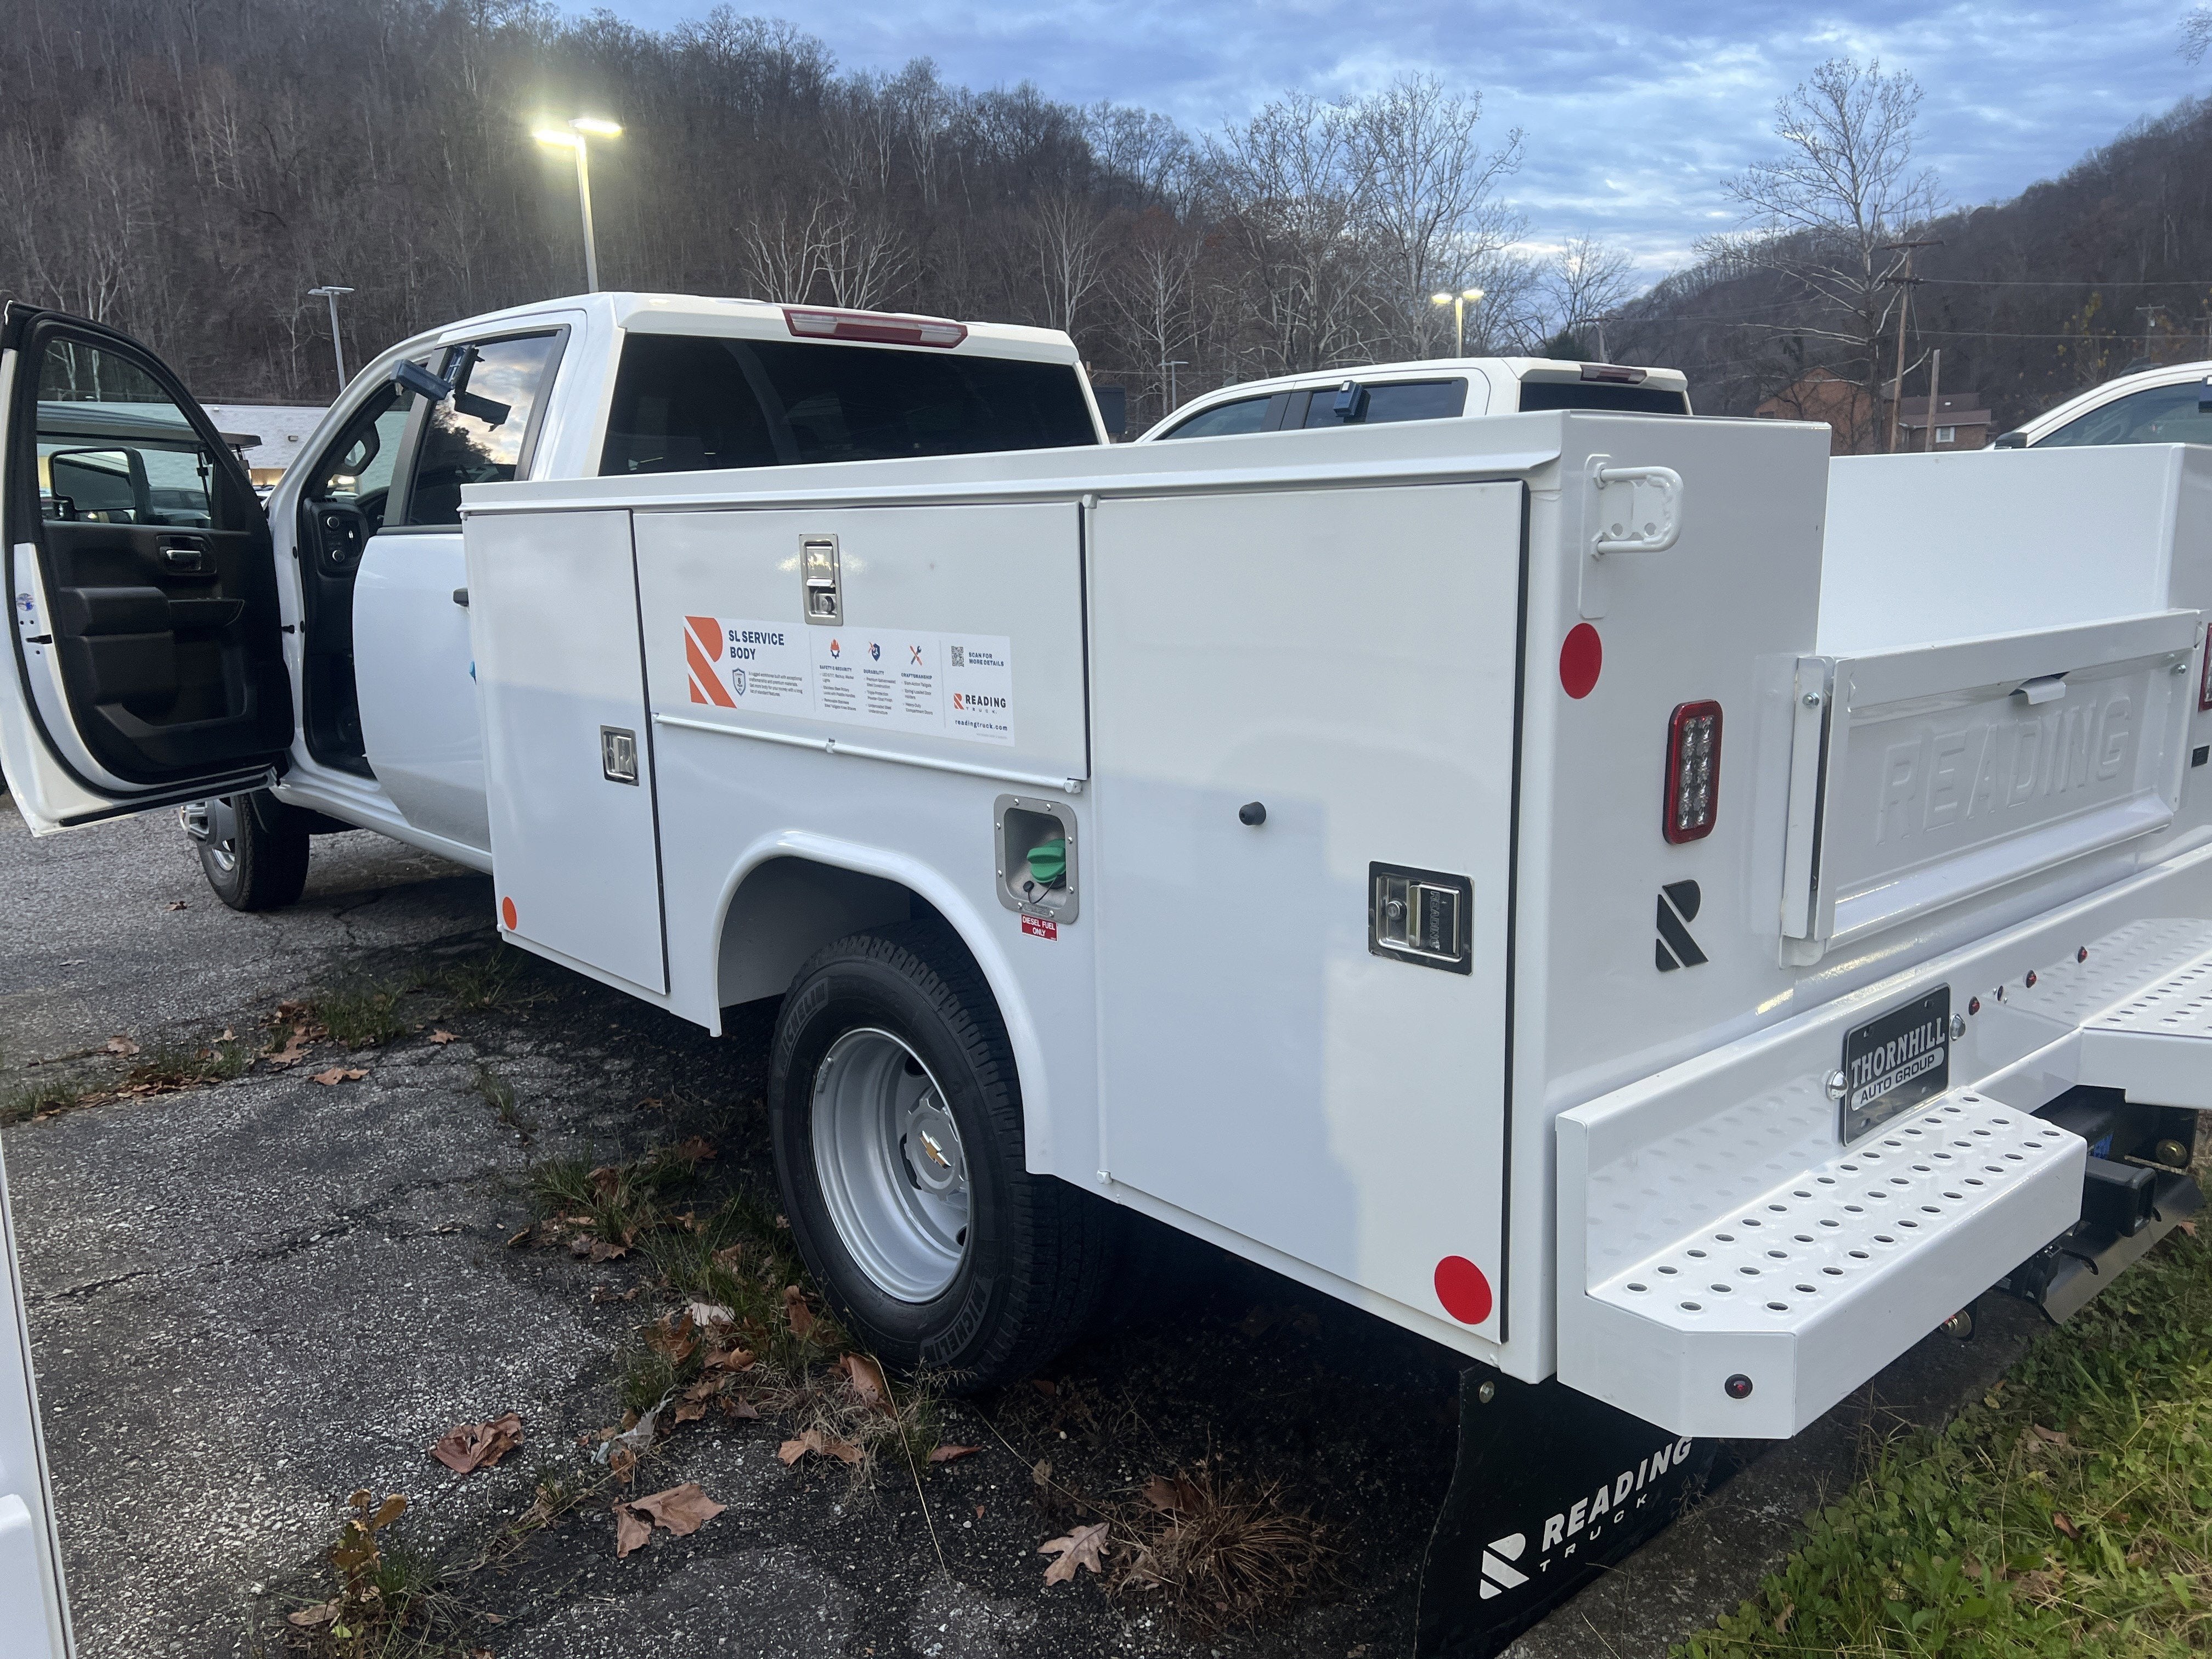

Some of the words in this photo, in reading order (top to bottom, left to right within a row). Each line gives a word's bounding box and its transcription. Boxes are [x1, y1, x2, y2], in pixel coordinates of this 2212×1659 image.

[729, 630, 741, 642] SL
[742, 631, 785, 646] SERVICE
[730, 646, 756, 660] BODY
[965, 694, 1007, 708] READING
[955, 719, 1008, 731] readingtruck.com
[1876, 695, 2133, 848] READING
[1022, 916, 1041, 927] DIESEL
[1042, 921, 1056, 930] FUEL
[1032, 927, 1046, 936] ONLY
[775, 982, 825, 1073] ICHELIN
[1850, 1017, 1945, 1090] THORNHILL
[1860, 1076, 1892, 1105] AUTO
[1895, 1054, 1935, 1084] GROUP
[1542, 1436, 1693, 1553] READING
[1539, 1493, 1647, 1572] TRUCK
